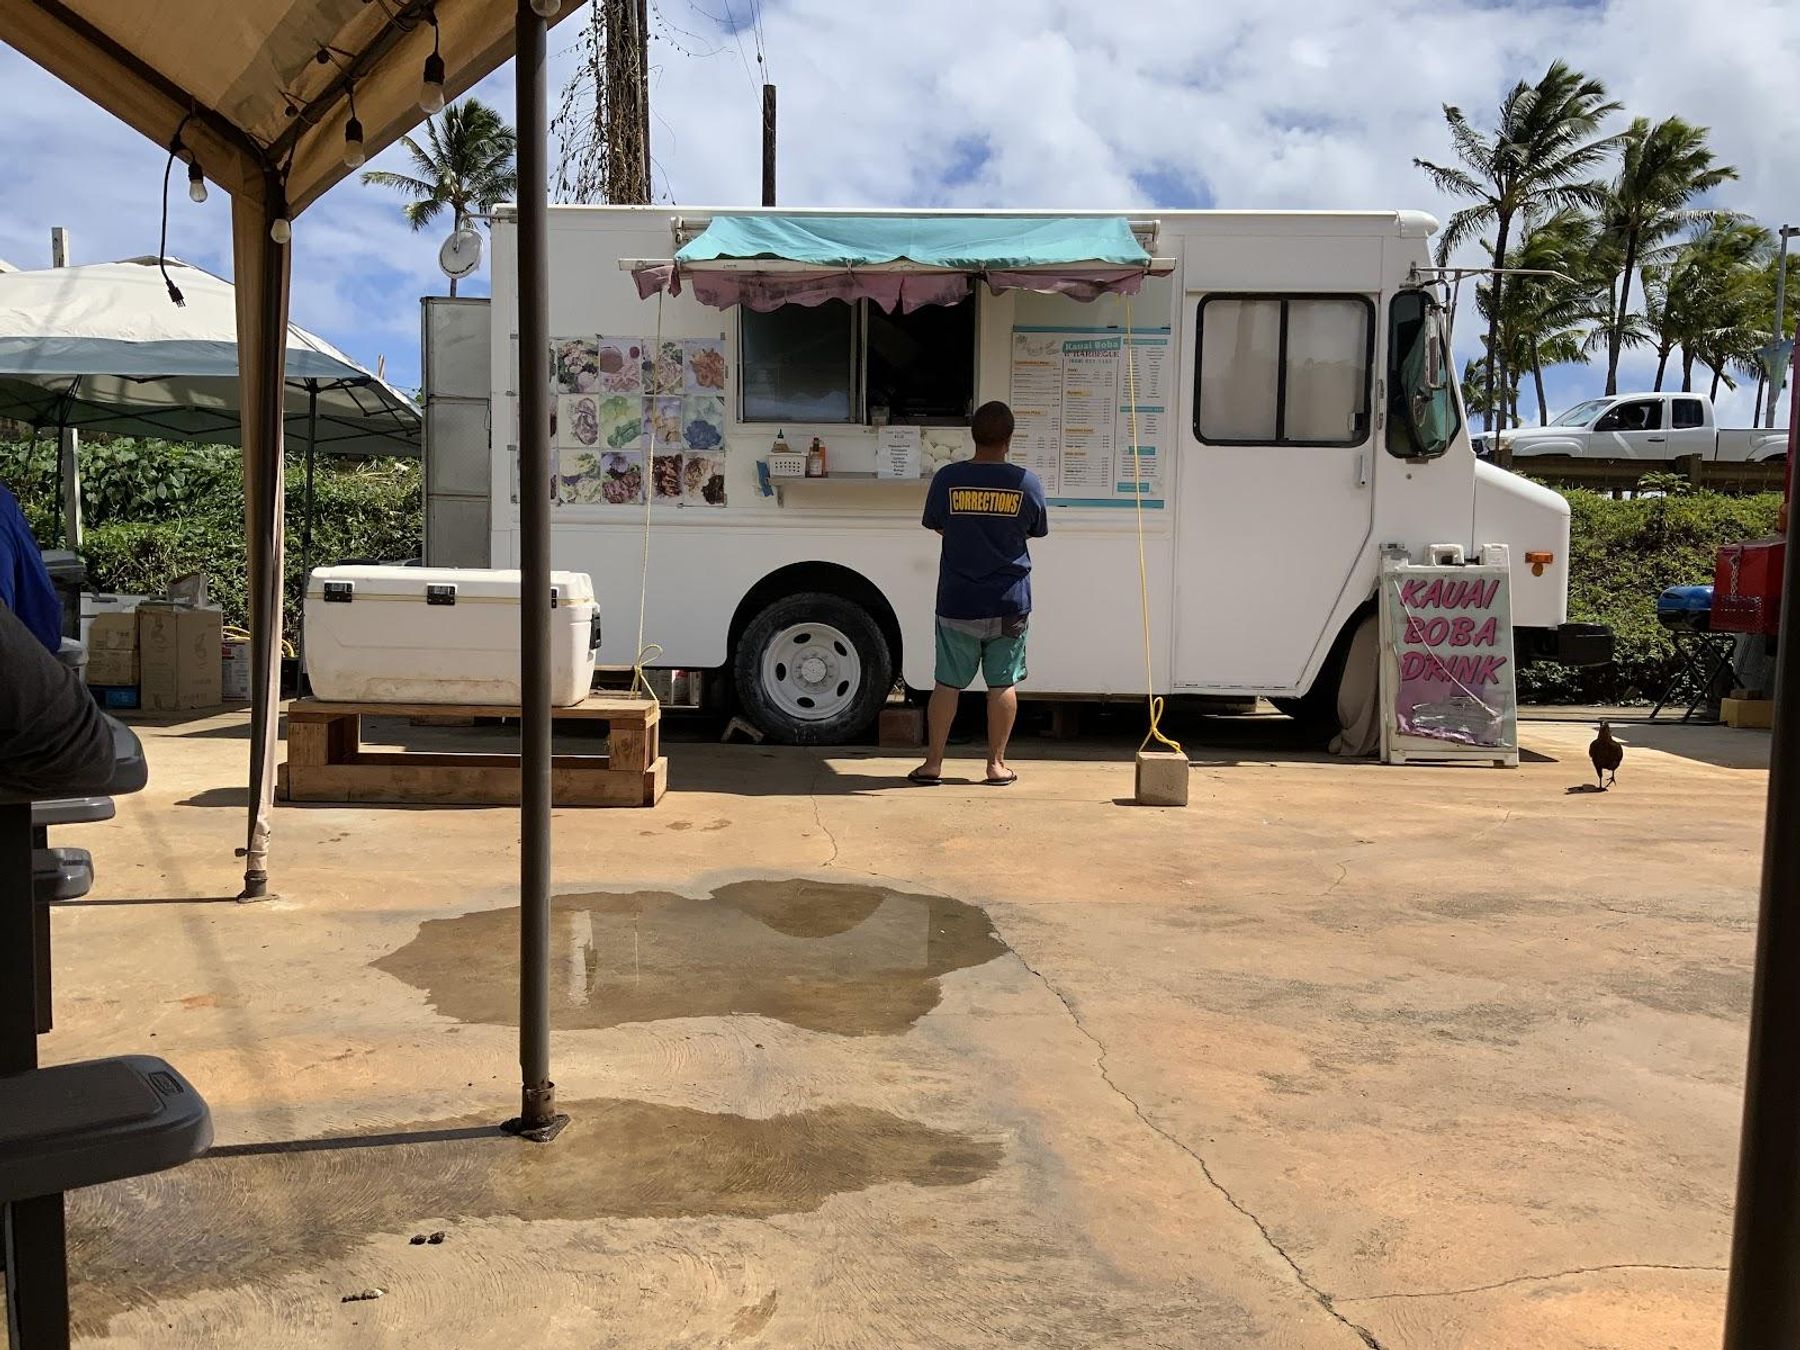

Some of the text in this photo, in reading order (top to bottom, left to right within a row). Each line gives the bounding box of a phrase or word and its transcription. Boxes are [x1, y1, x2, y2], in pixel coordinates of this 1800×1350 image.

[1094, 340, 1119, 349] Boba
[952, 490, 1020, 513] CORRECTIONS
[1400, 578, 1500, 609] KAUAI
[1403, 616, 1497, 647] BOBA
[1401, 651, 1507, 685] DRINK
